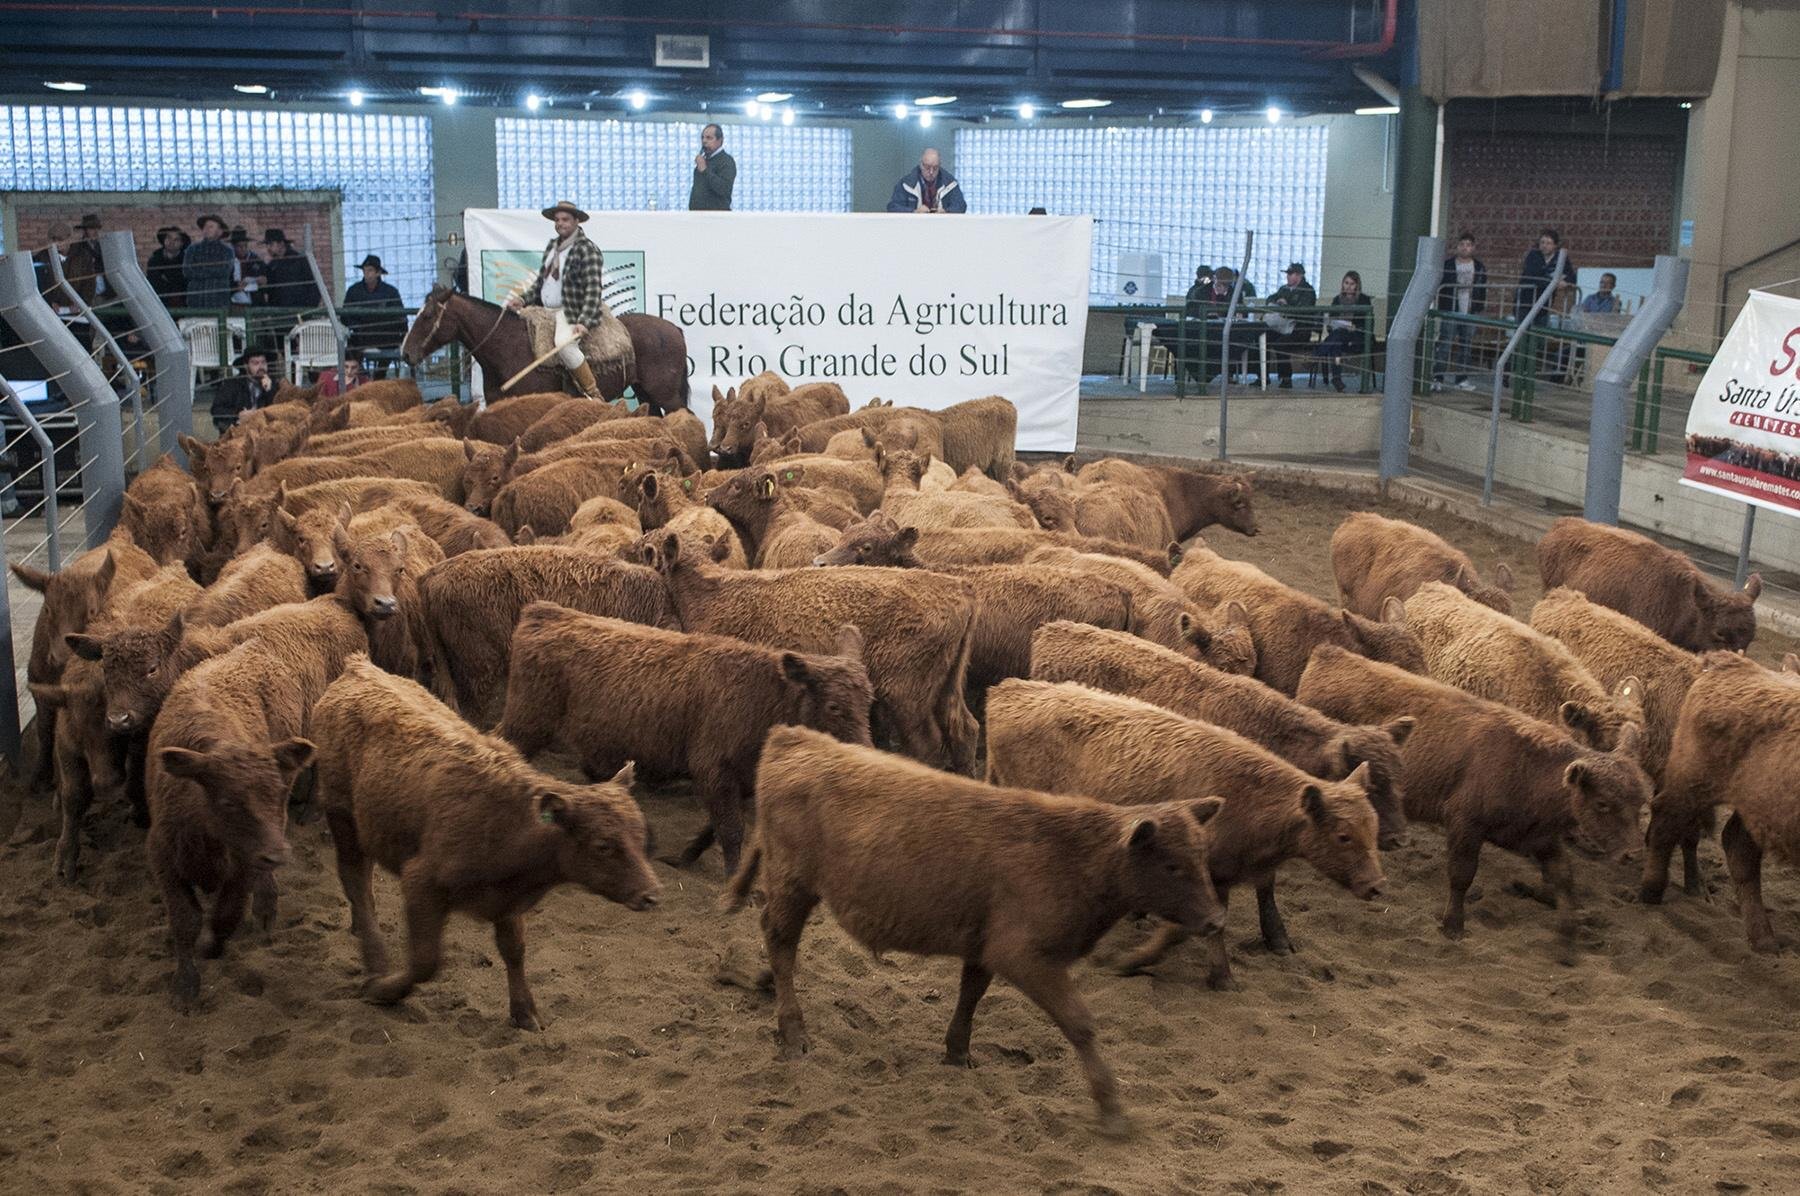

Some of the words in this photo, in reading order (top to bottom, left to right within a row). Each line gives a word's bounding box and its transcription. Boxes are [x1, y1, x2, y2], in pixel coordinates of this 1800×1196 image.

[656, 292, 826, 334] Federação
[837, 292, 874, 326] da
[886, 292, 1068, 335] Agricultura
[709, 344, 767, 377] Rio
[779, 344, 897, 378] Grande
[908, 344, 947, 377] do
[959, 344, 1009, 377] Sul
[1719, 378, 1771, 410] Santa
